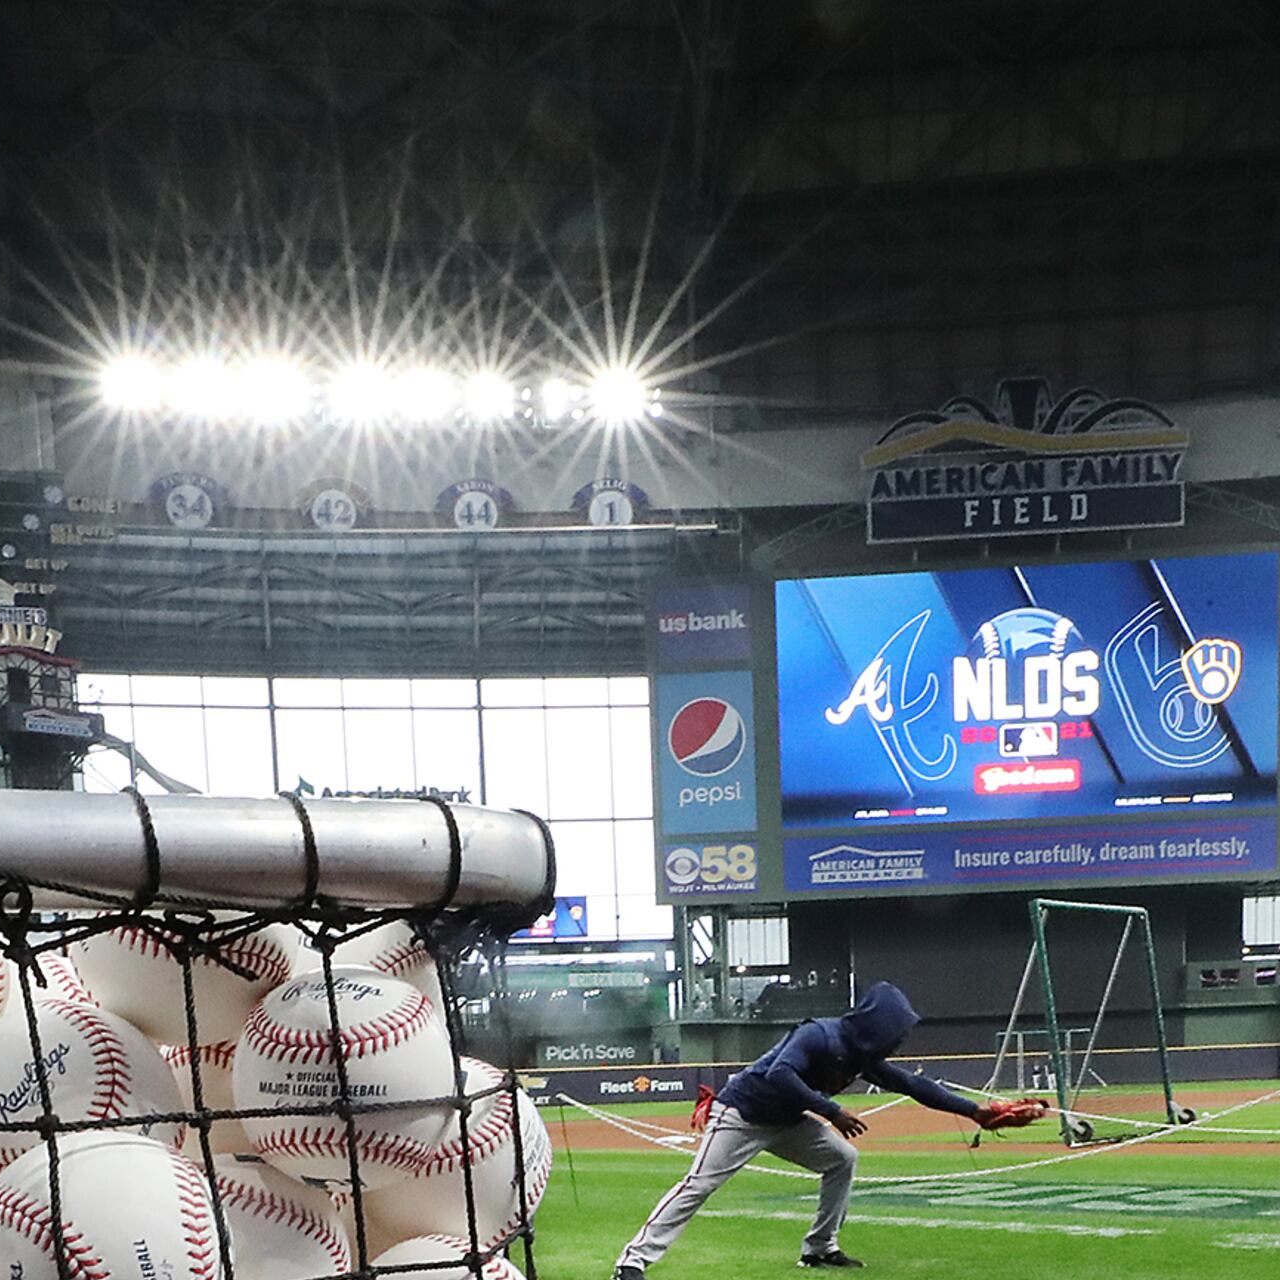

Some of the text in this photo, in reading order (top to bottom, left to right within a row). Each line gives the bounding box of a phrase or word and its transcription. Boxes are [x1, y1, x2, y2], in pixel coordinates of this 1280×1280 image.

[870, 451, 1183, 500] AMERICAN FAMILY
[170, 494, 209, 519] 34
[316, 498, 353, 523] 42
[460, 501, 493, 526] 44
[605, 501, 618, 524] 1
[964, 493, 1088, 528] FIELD
[952, 649, 1101, 722] NLDS
[678, 781, 742, 807] pepsi
[701, 845, 758, 883] 58
[812, 856, 924, 872] AMERICAN FAMILY
[954, 836, 1251, 868] Insure carefully, dream fearlessly.
[820, 869, 916, 881] INSURANCE
[546, 1045, 580, 1061] Pick
[595, 1044, 635, 1059] Save
[259, 1082, 291, 1096] MAJOR
[293, 1084, 329, 1097] LEAGUE
[296, 1071, 338, 1083] OFFICIAL
[600, 1079, 683, 1094] Fleet Farm
